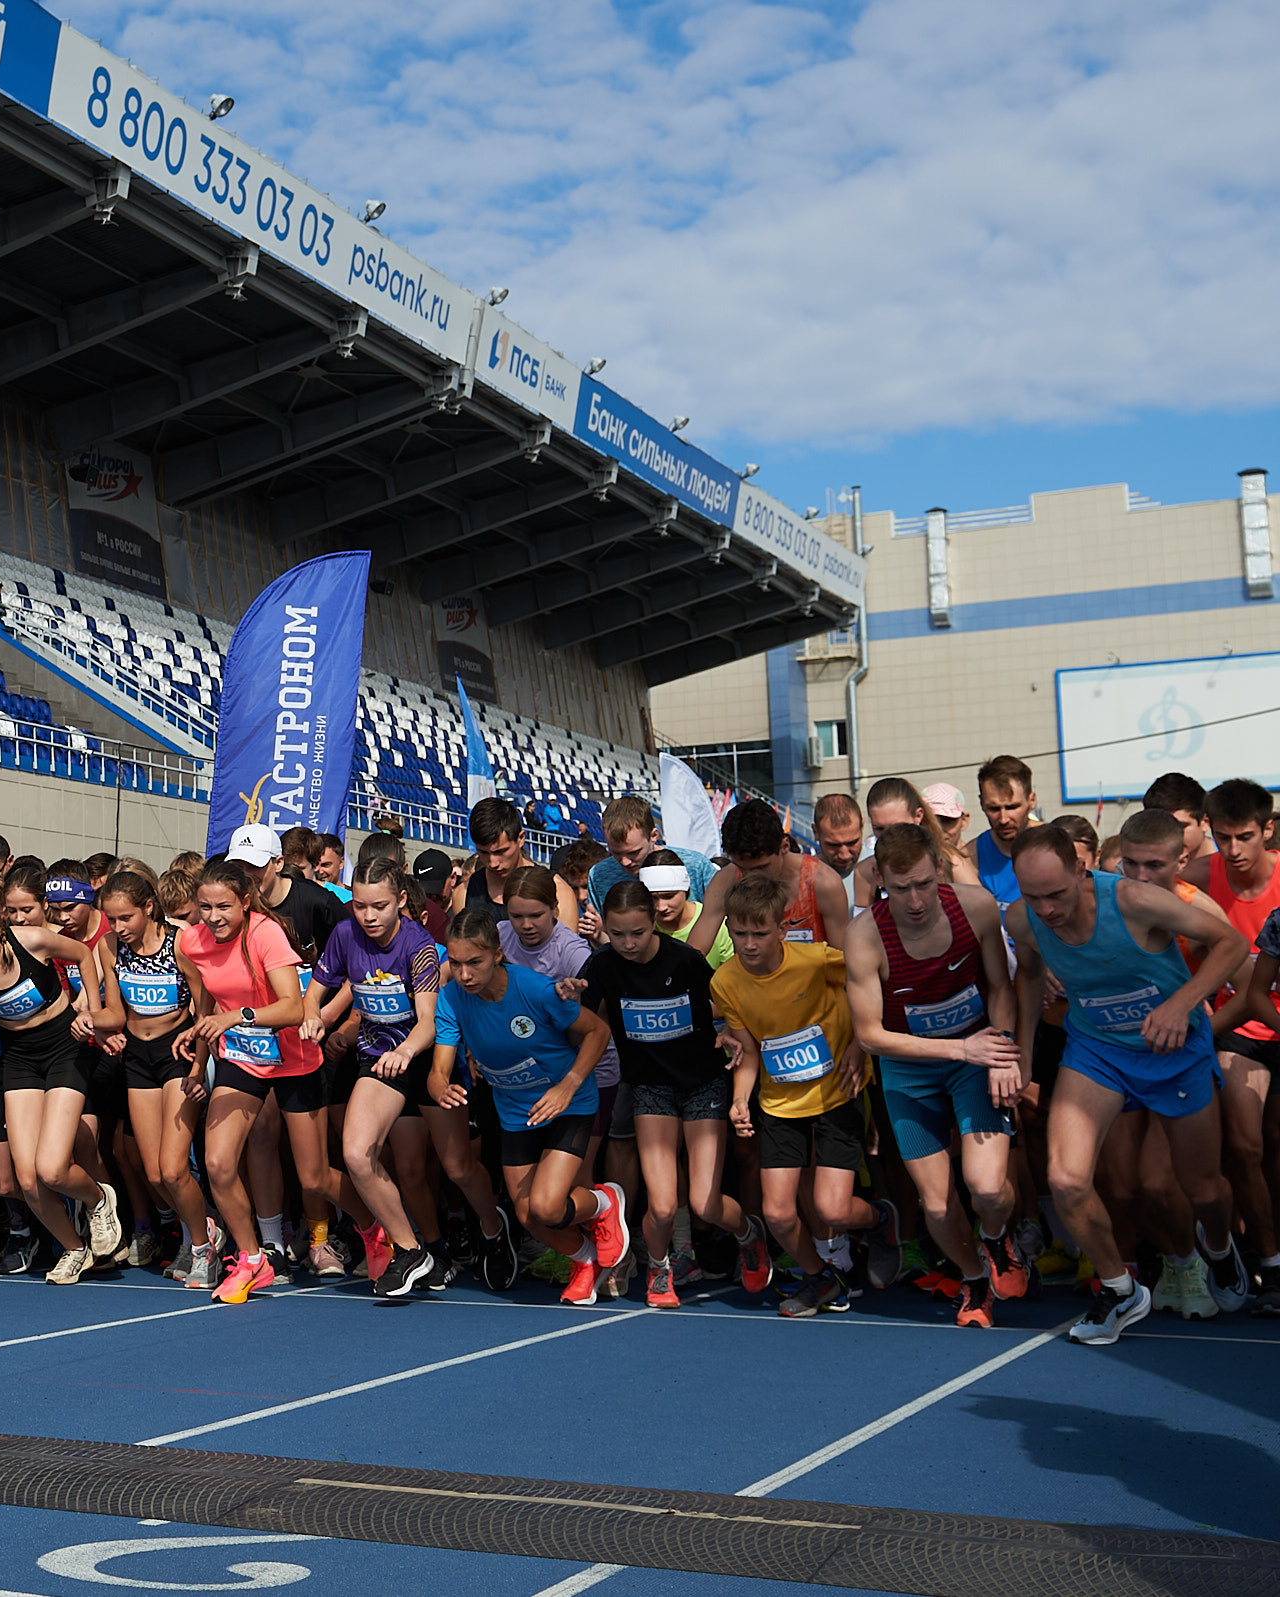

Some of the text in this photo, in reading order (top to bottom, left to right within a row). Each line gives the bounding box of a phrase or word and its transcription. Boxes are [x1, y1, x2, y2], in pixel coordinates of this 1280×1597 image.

[88, 66, 450, 332] 8 800 333 03 03 psbank.ru
[509, 345, 567, 402] ПСБ БАНК
[587, 392, 732, 514] Банк сильных людей
[744, 495, 752, 526] 8
[753, 502, 774, 538] 800
[775, 516, 793, 551] 333
[794, 529, 807, 559] 03
[807, 538, 821, 568] 03
[313, 715, 327, 763] ЖИЗНИ
[128, 986, 168, 1003] 1502
[359, 997, 400, 1012] 1513
[633, 1011, 680, 1030] 1561
[921, 1004, 973, 1029] 1572
[1099, 1001, 1153, 1023] 1563
[231, 1035, 271, 1056] 1562
[772, 1044, 820, 1071] 1600
[489, 1071, 535, 1085] 1542
